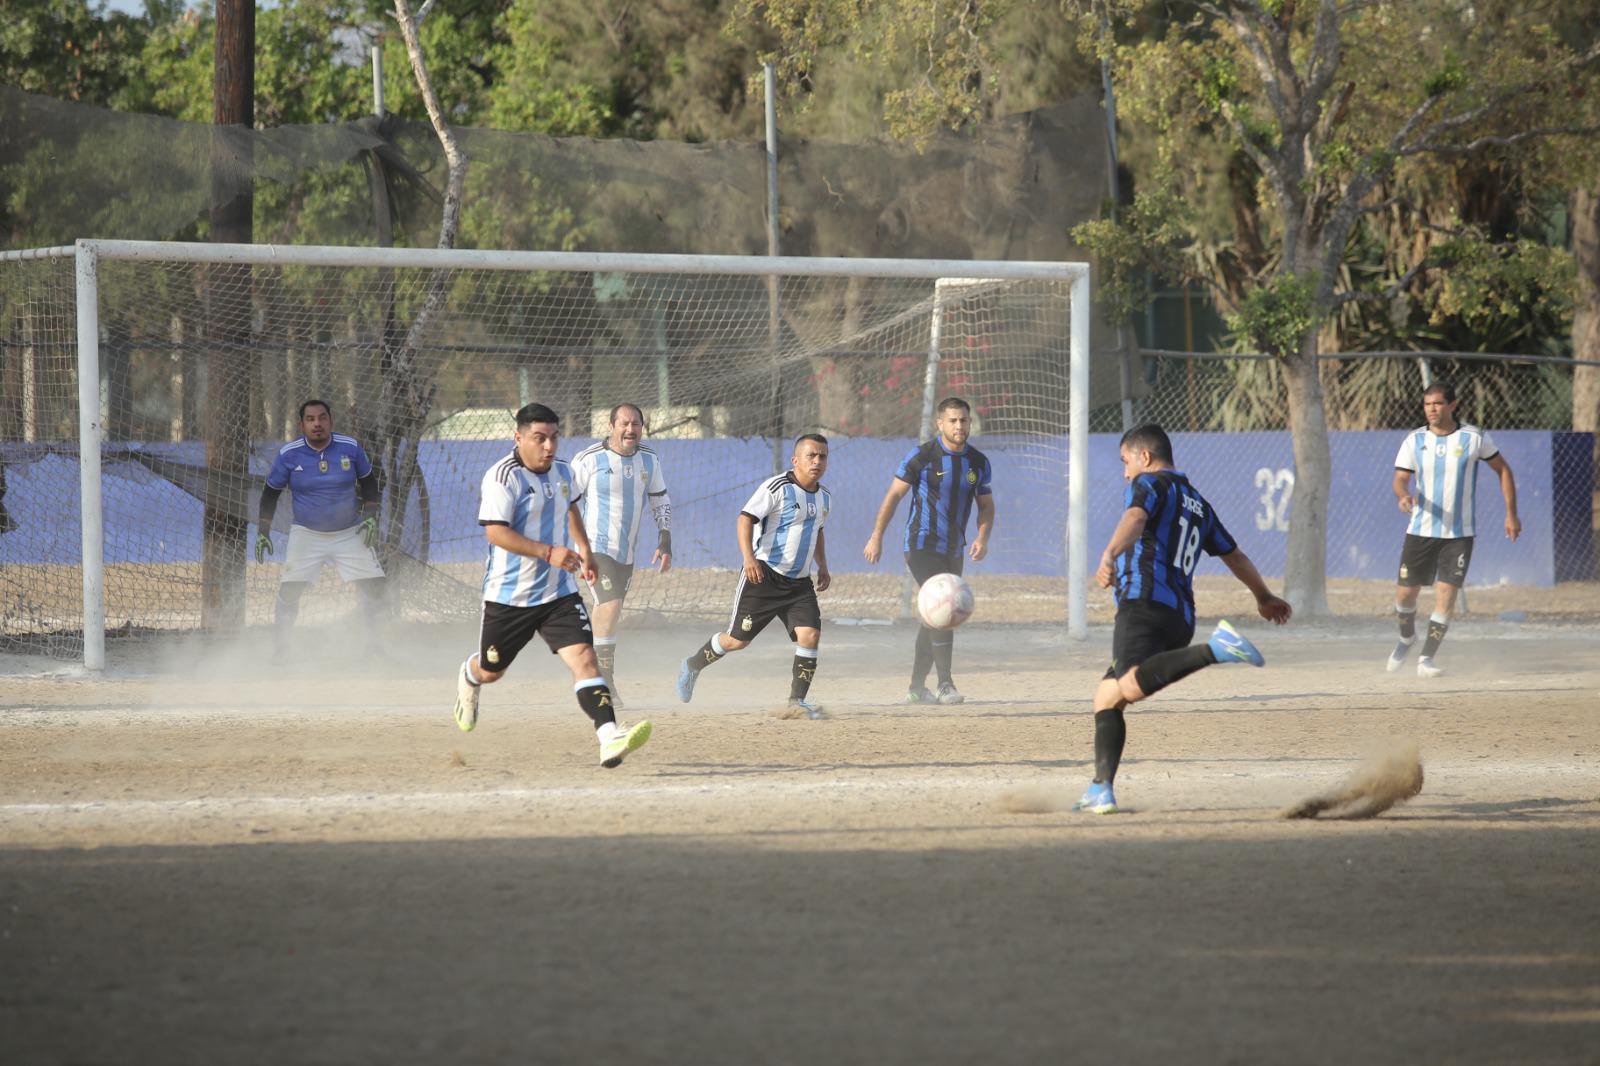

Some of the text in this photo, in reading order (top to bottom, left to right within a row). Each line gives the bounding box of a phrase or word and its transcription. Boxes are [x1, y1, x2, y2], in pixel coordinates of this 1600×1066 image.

[1255, 467, 1295, 532] 32
[1173, 516, 1200, 577] 18
[1457, 553, 1465, 568] 6
